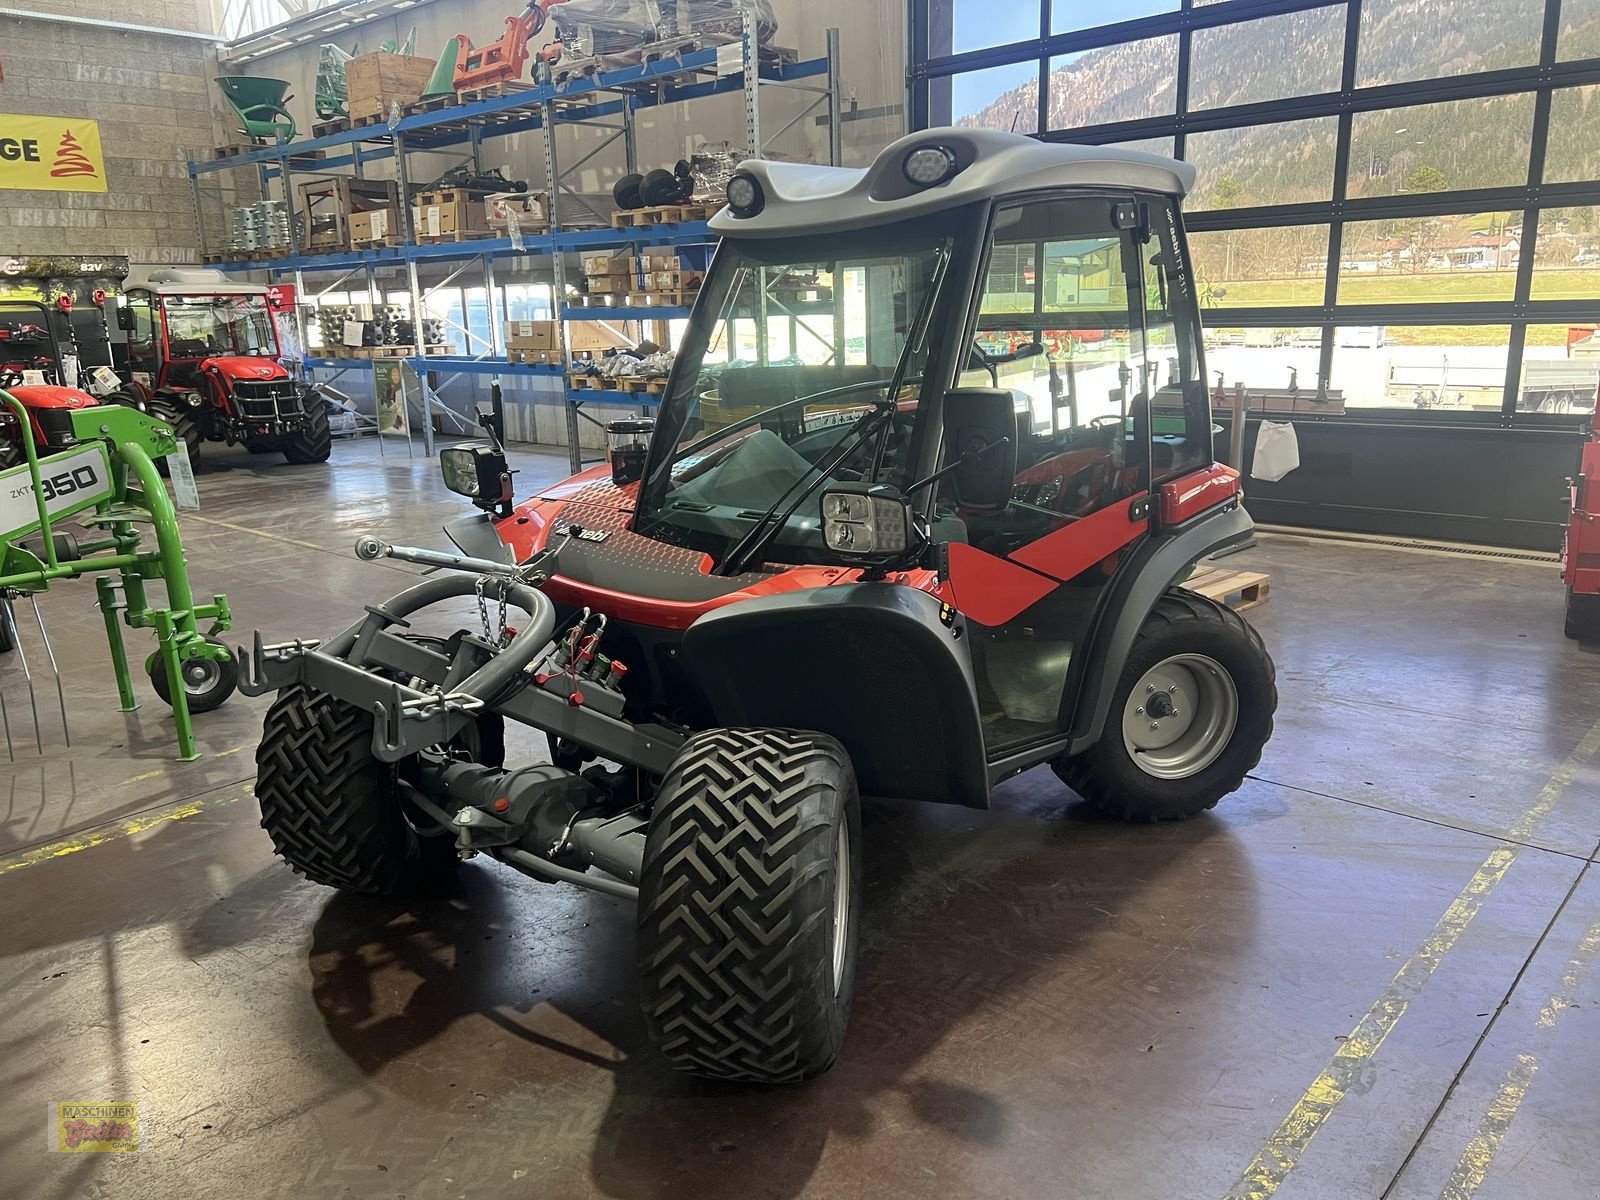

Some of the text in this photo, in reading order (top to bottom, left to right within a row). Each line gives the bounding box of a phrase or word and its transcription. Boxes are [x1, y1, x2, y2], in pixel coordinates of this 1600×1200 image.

[0, 138, 40, 162] GE
[80, 263, 103, 272] 82V
[9, 485, 30, 499] ZKT
